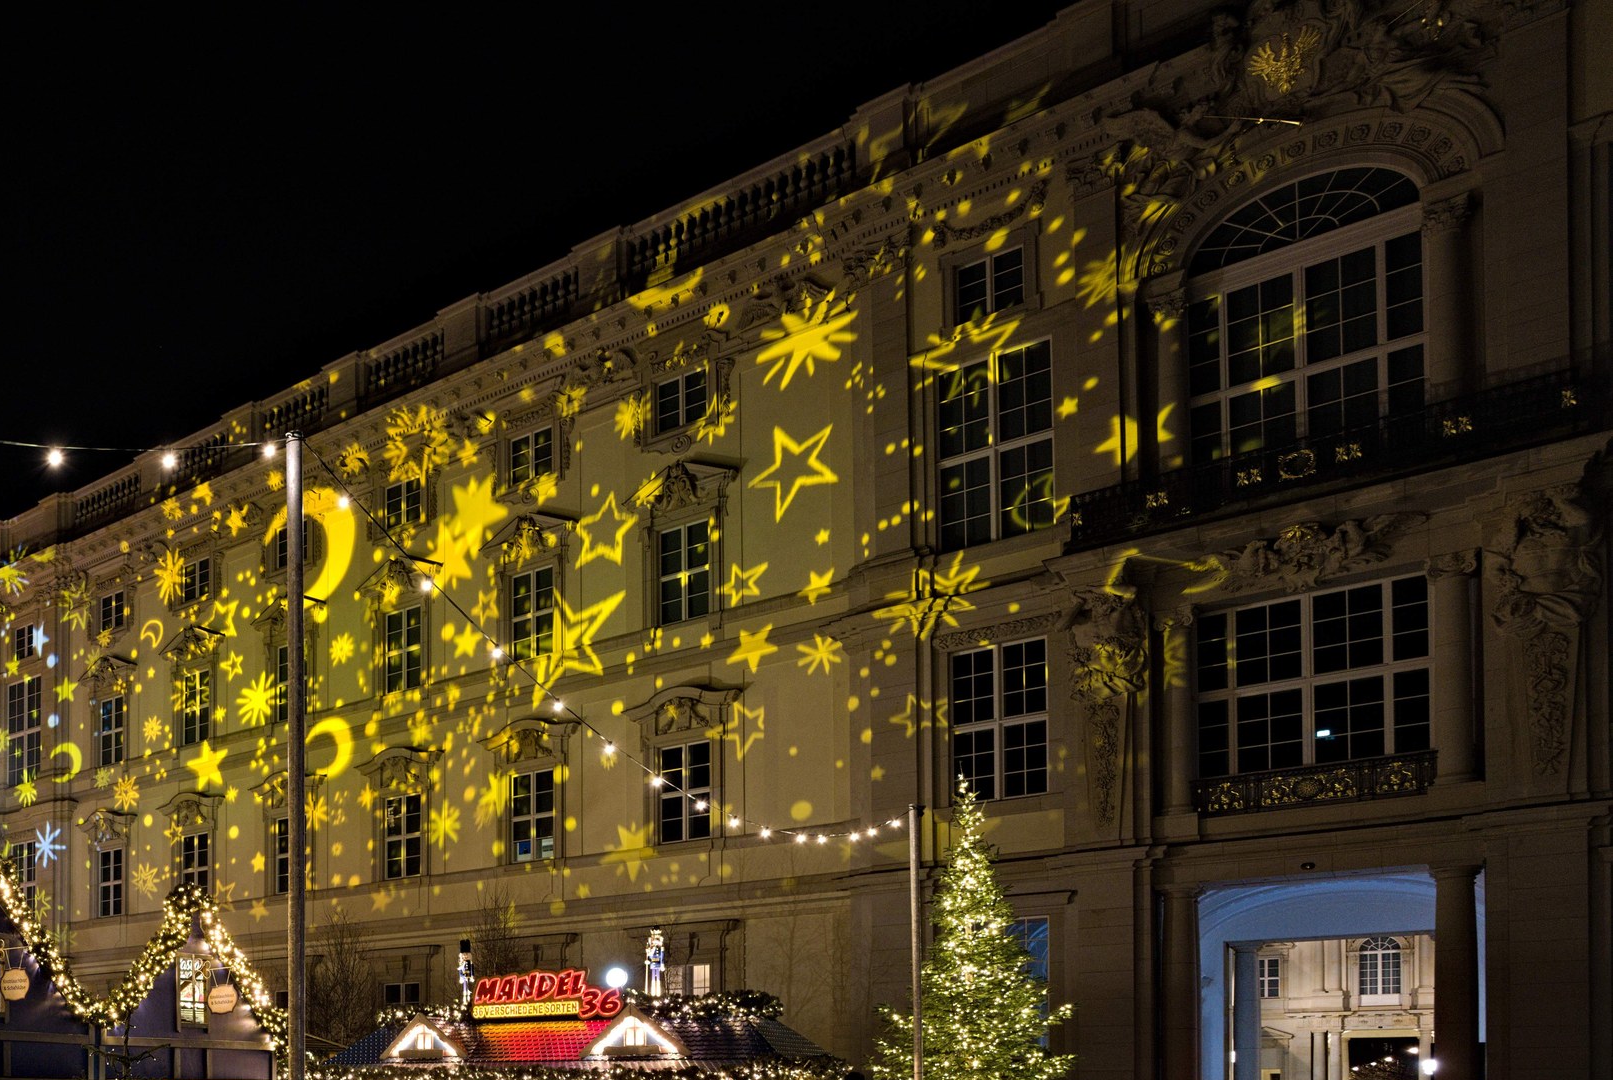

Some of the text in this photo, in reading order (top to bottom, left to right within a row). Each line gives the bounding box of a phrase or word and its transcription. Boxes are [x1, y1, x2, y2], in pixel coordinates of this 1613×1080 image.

[475, 970, 622, 1019] MANDEL 36
[484, 1004, 543, 1016] VERSCHIEDENE
[545, 1002, 578, 1013] SORTEN
